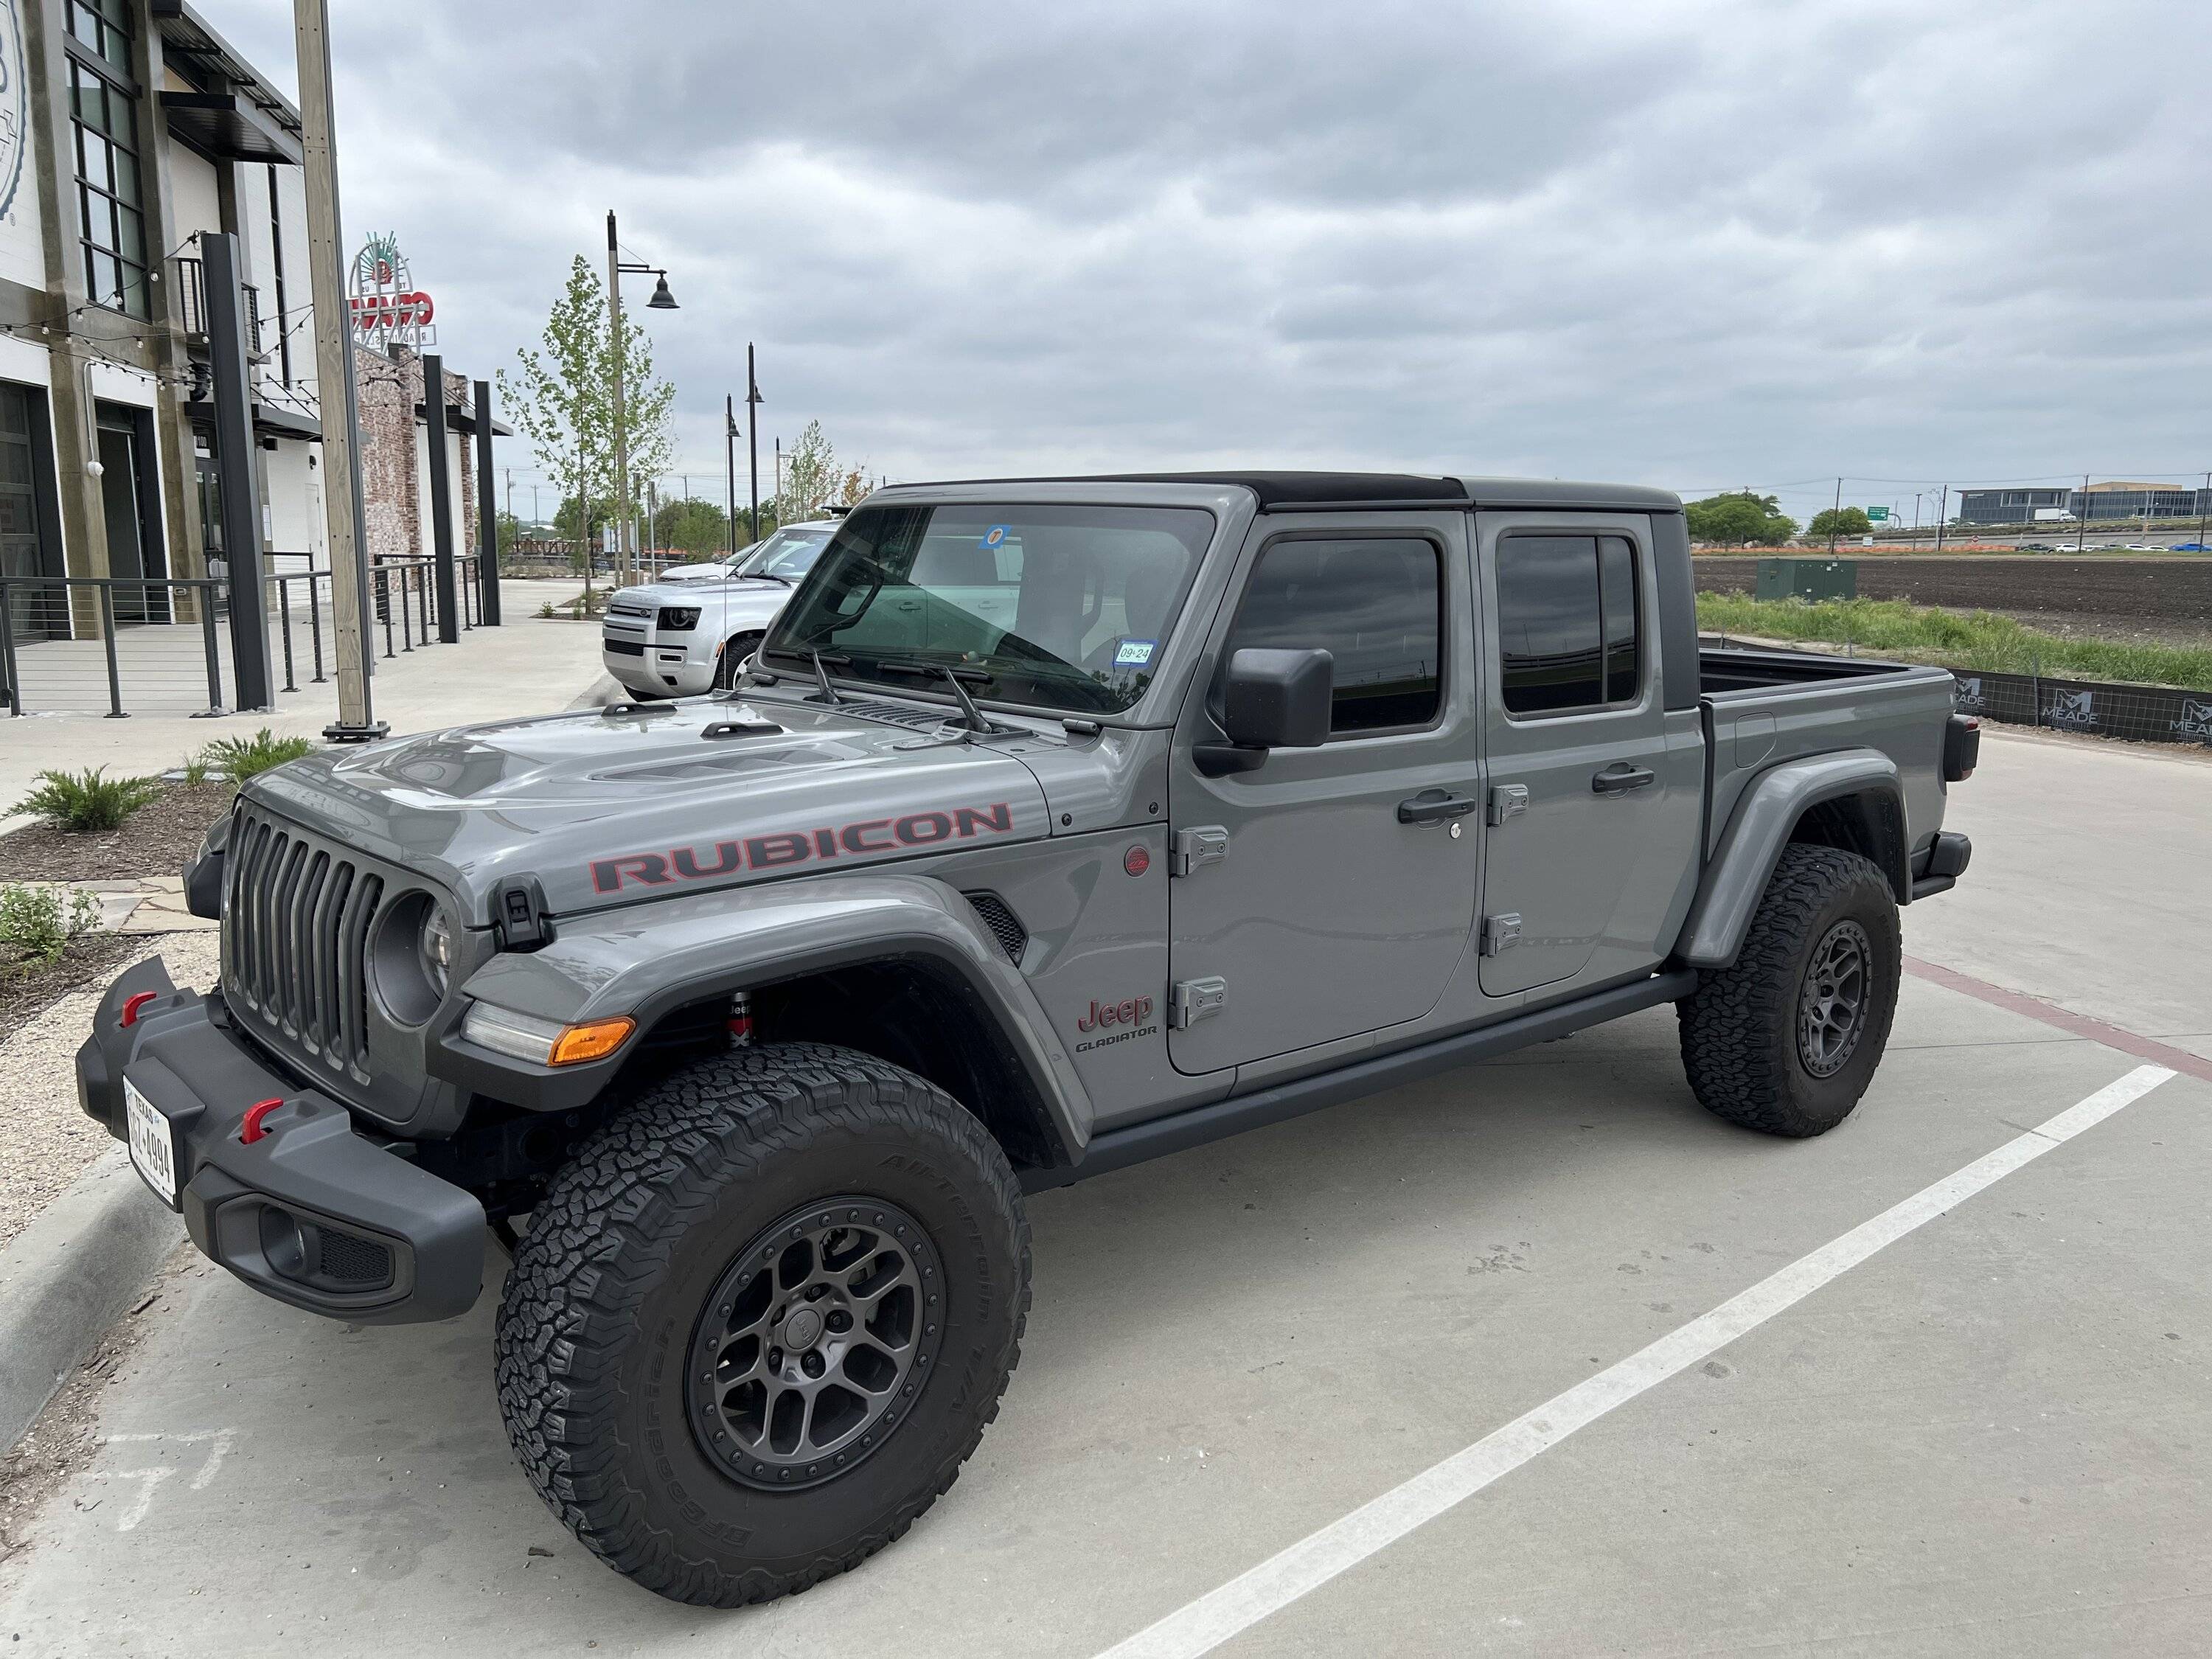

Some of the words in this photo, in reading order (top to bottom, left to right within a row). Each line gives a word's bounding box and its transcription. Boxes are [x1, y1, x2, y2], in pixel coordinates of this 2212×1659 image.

[1120, 649, 1133, 658] 09
[1135, 649, 1150, 658] 24
[1956, 695, 1986, 706] ADE
[2042, 707, 2098, 723] MEADE
[2170, 720, 2212, 736] MEA
[590, 802, 1014, 894] RUBICON
[729, 1004, 751, 1015] Jeep
[1079, 995, 1153, 1033] Jeep
[1076, 1026, 1158, 1053] GLADIATOR
[134, 1093, 153, 1125] TEXAS
